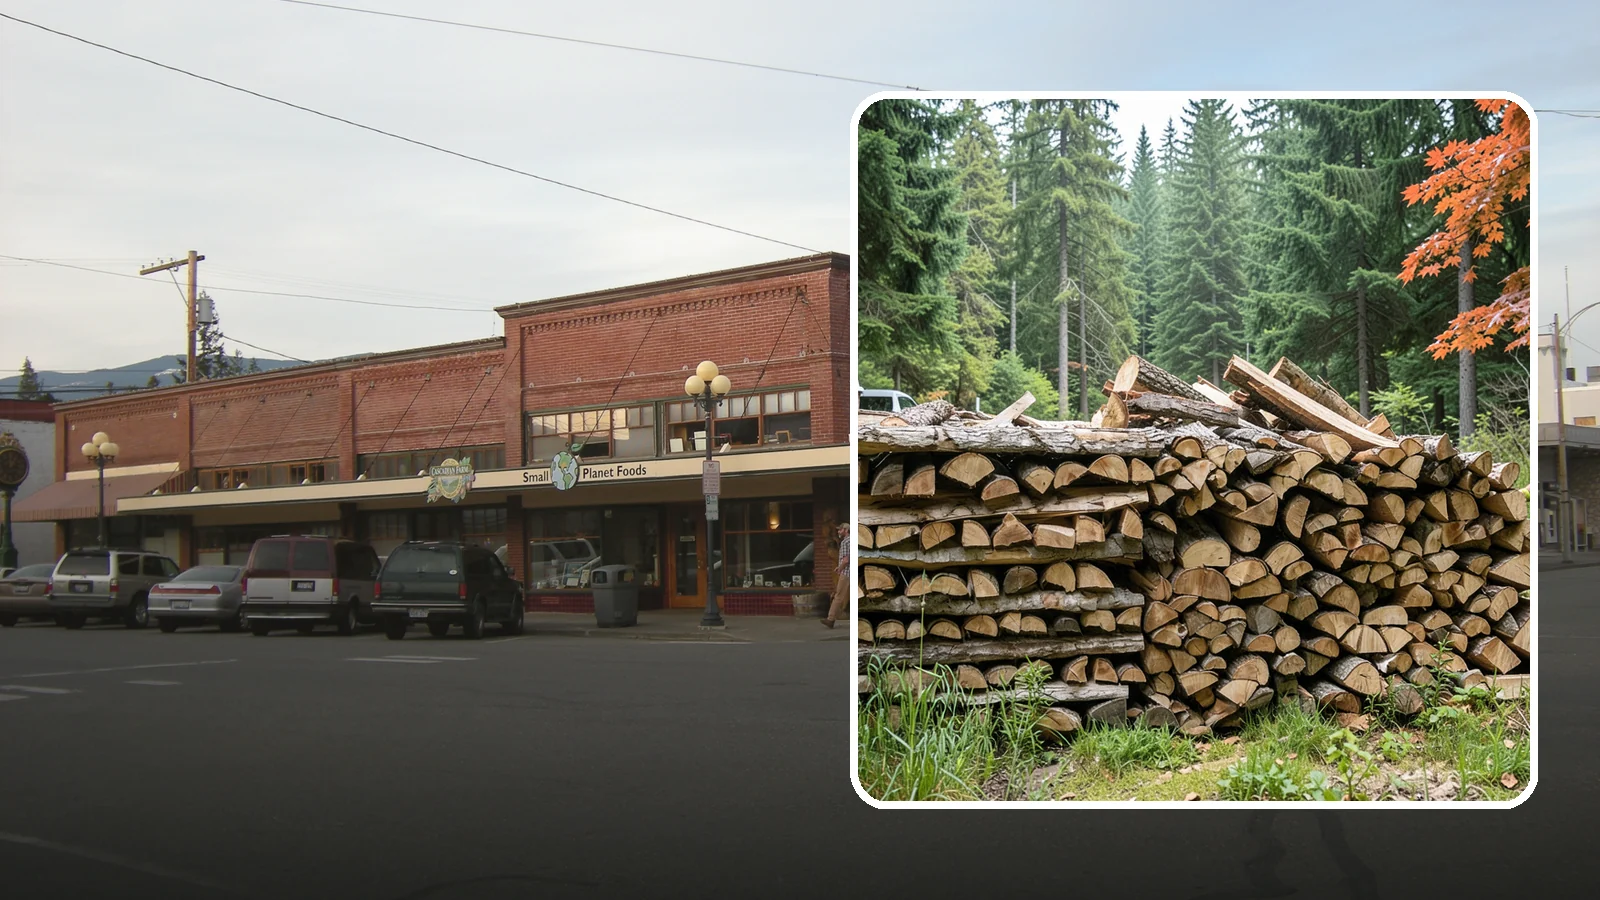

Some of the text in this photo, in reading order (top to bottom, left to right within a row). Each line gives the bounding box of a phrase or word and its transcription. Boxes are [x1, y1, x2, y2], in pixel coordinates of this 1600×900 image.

[523, 464, 647, 483] Small Planet Foods
